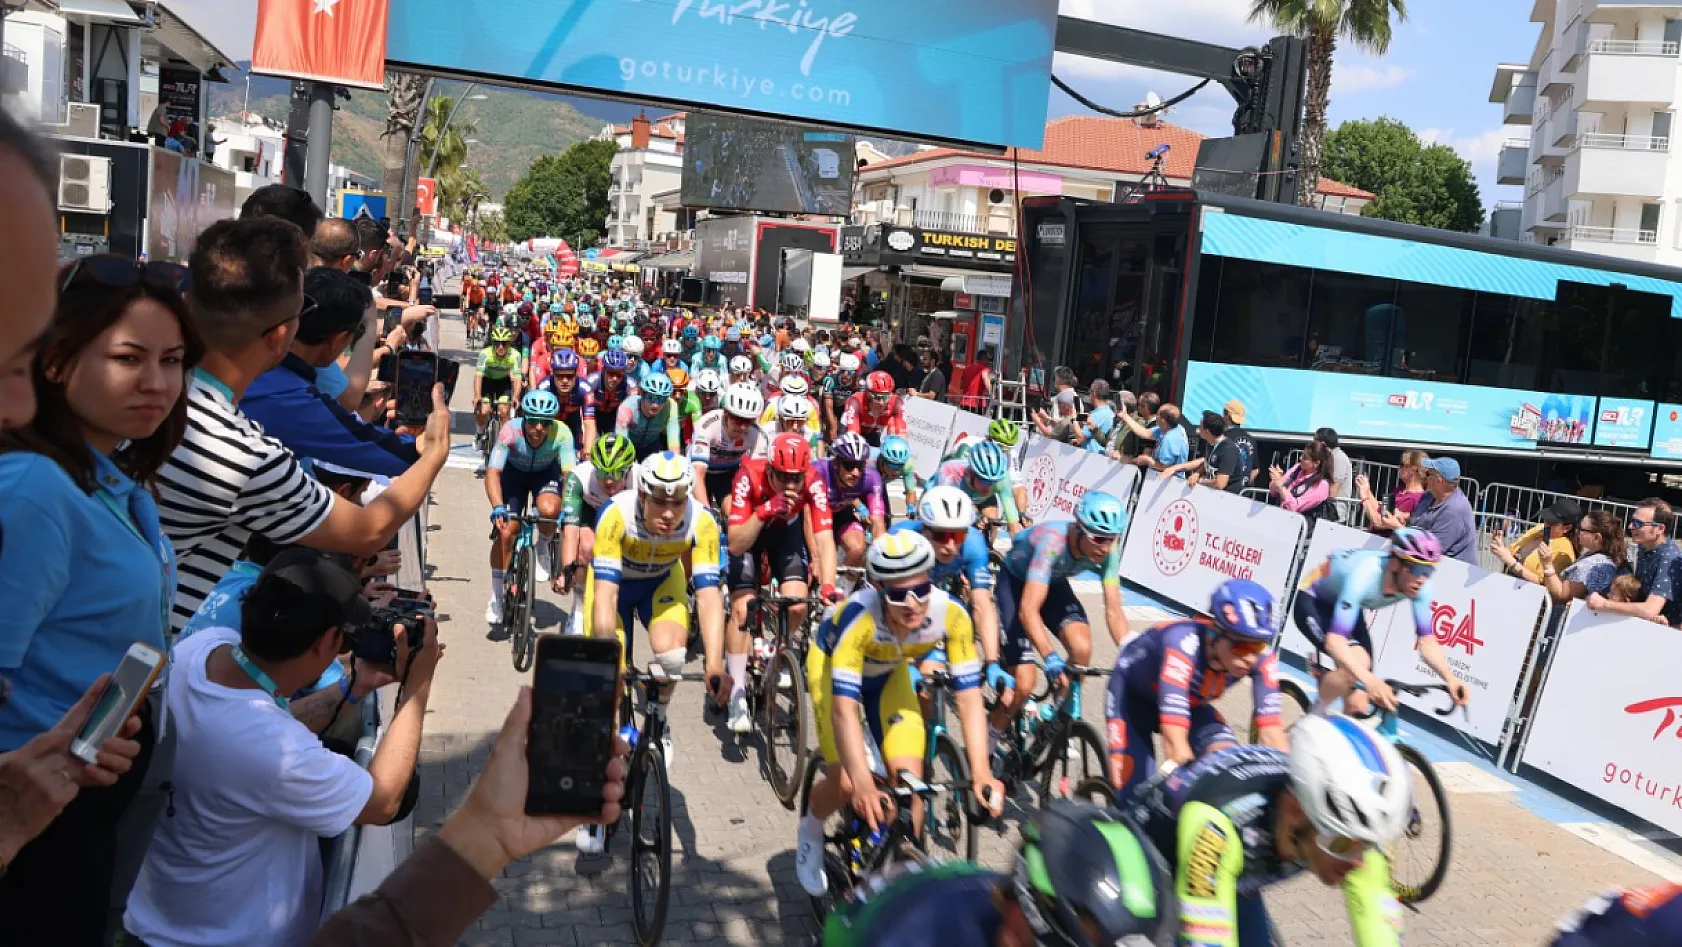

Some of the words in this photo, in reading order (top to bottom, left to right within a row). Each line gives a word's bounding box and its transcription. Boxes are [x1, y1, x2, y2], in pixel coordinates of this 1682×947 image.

[619, 57, 850, 106] goturkiye.com
[922, 231, 989, 249] TURKISH
[995, 239, 1017, 252] DE
[1205, 533, 1220, 551] T.C.
[1221, 537, 1263, 566] İÇİŞLERİ
[1199, 551, 1254, 579] BAKANLIĞI
